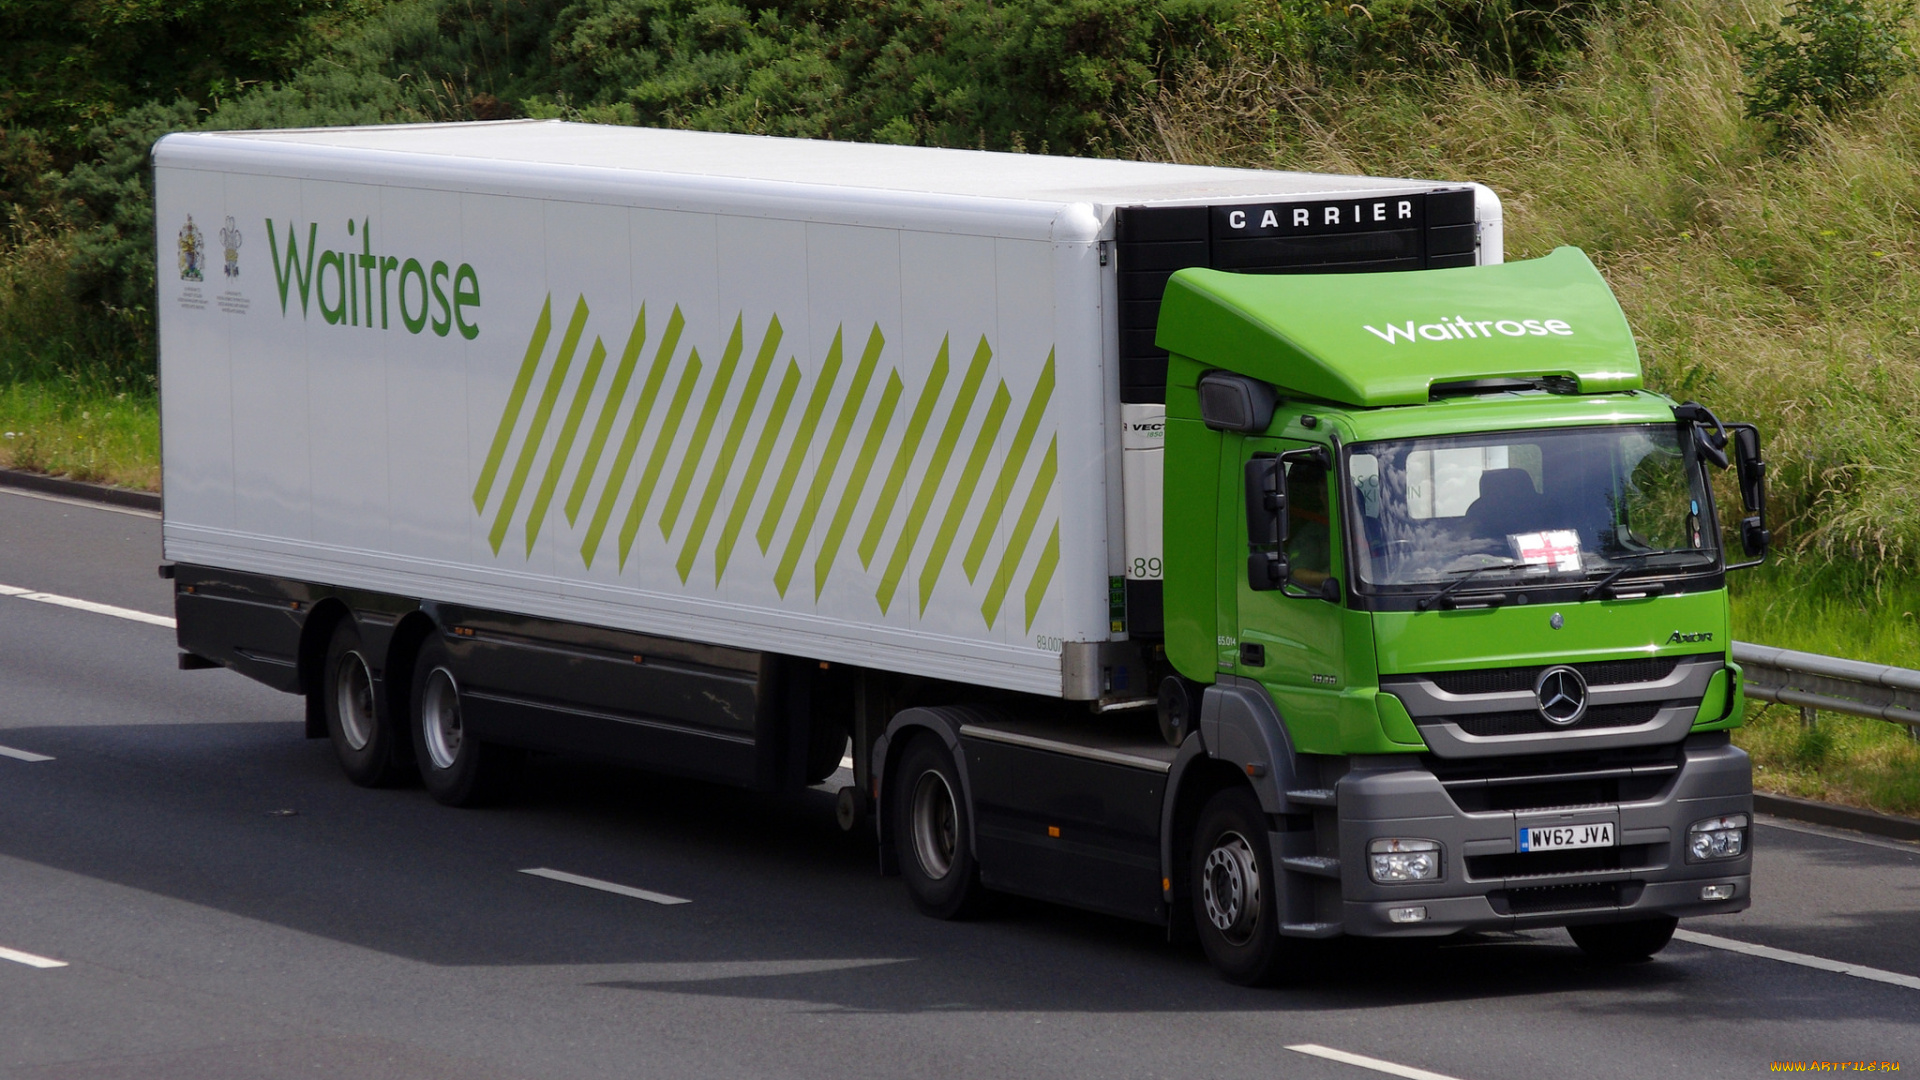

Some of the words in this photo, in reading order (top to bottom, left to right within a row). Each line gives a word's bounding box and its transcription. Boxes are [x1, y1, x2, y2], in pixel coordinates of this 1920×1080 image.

[1229, 200, 1412, 230] CARRIER
[264, 214, 481, 341] Waitrose
[1362, 314, 1574, 345] Waitrose
[1134, 557, 1162, 578] 89
[1532, 828, 1574, 847] WV62
[1580, 826, 1610, 844] JVA
